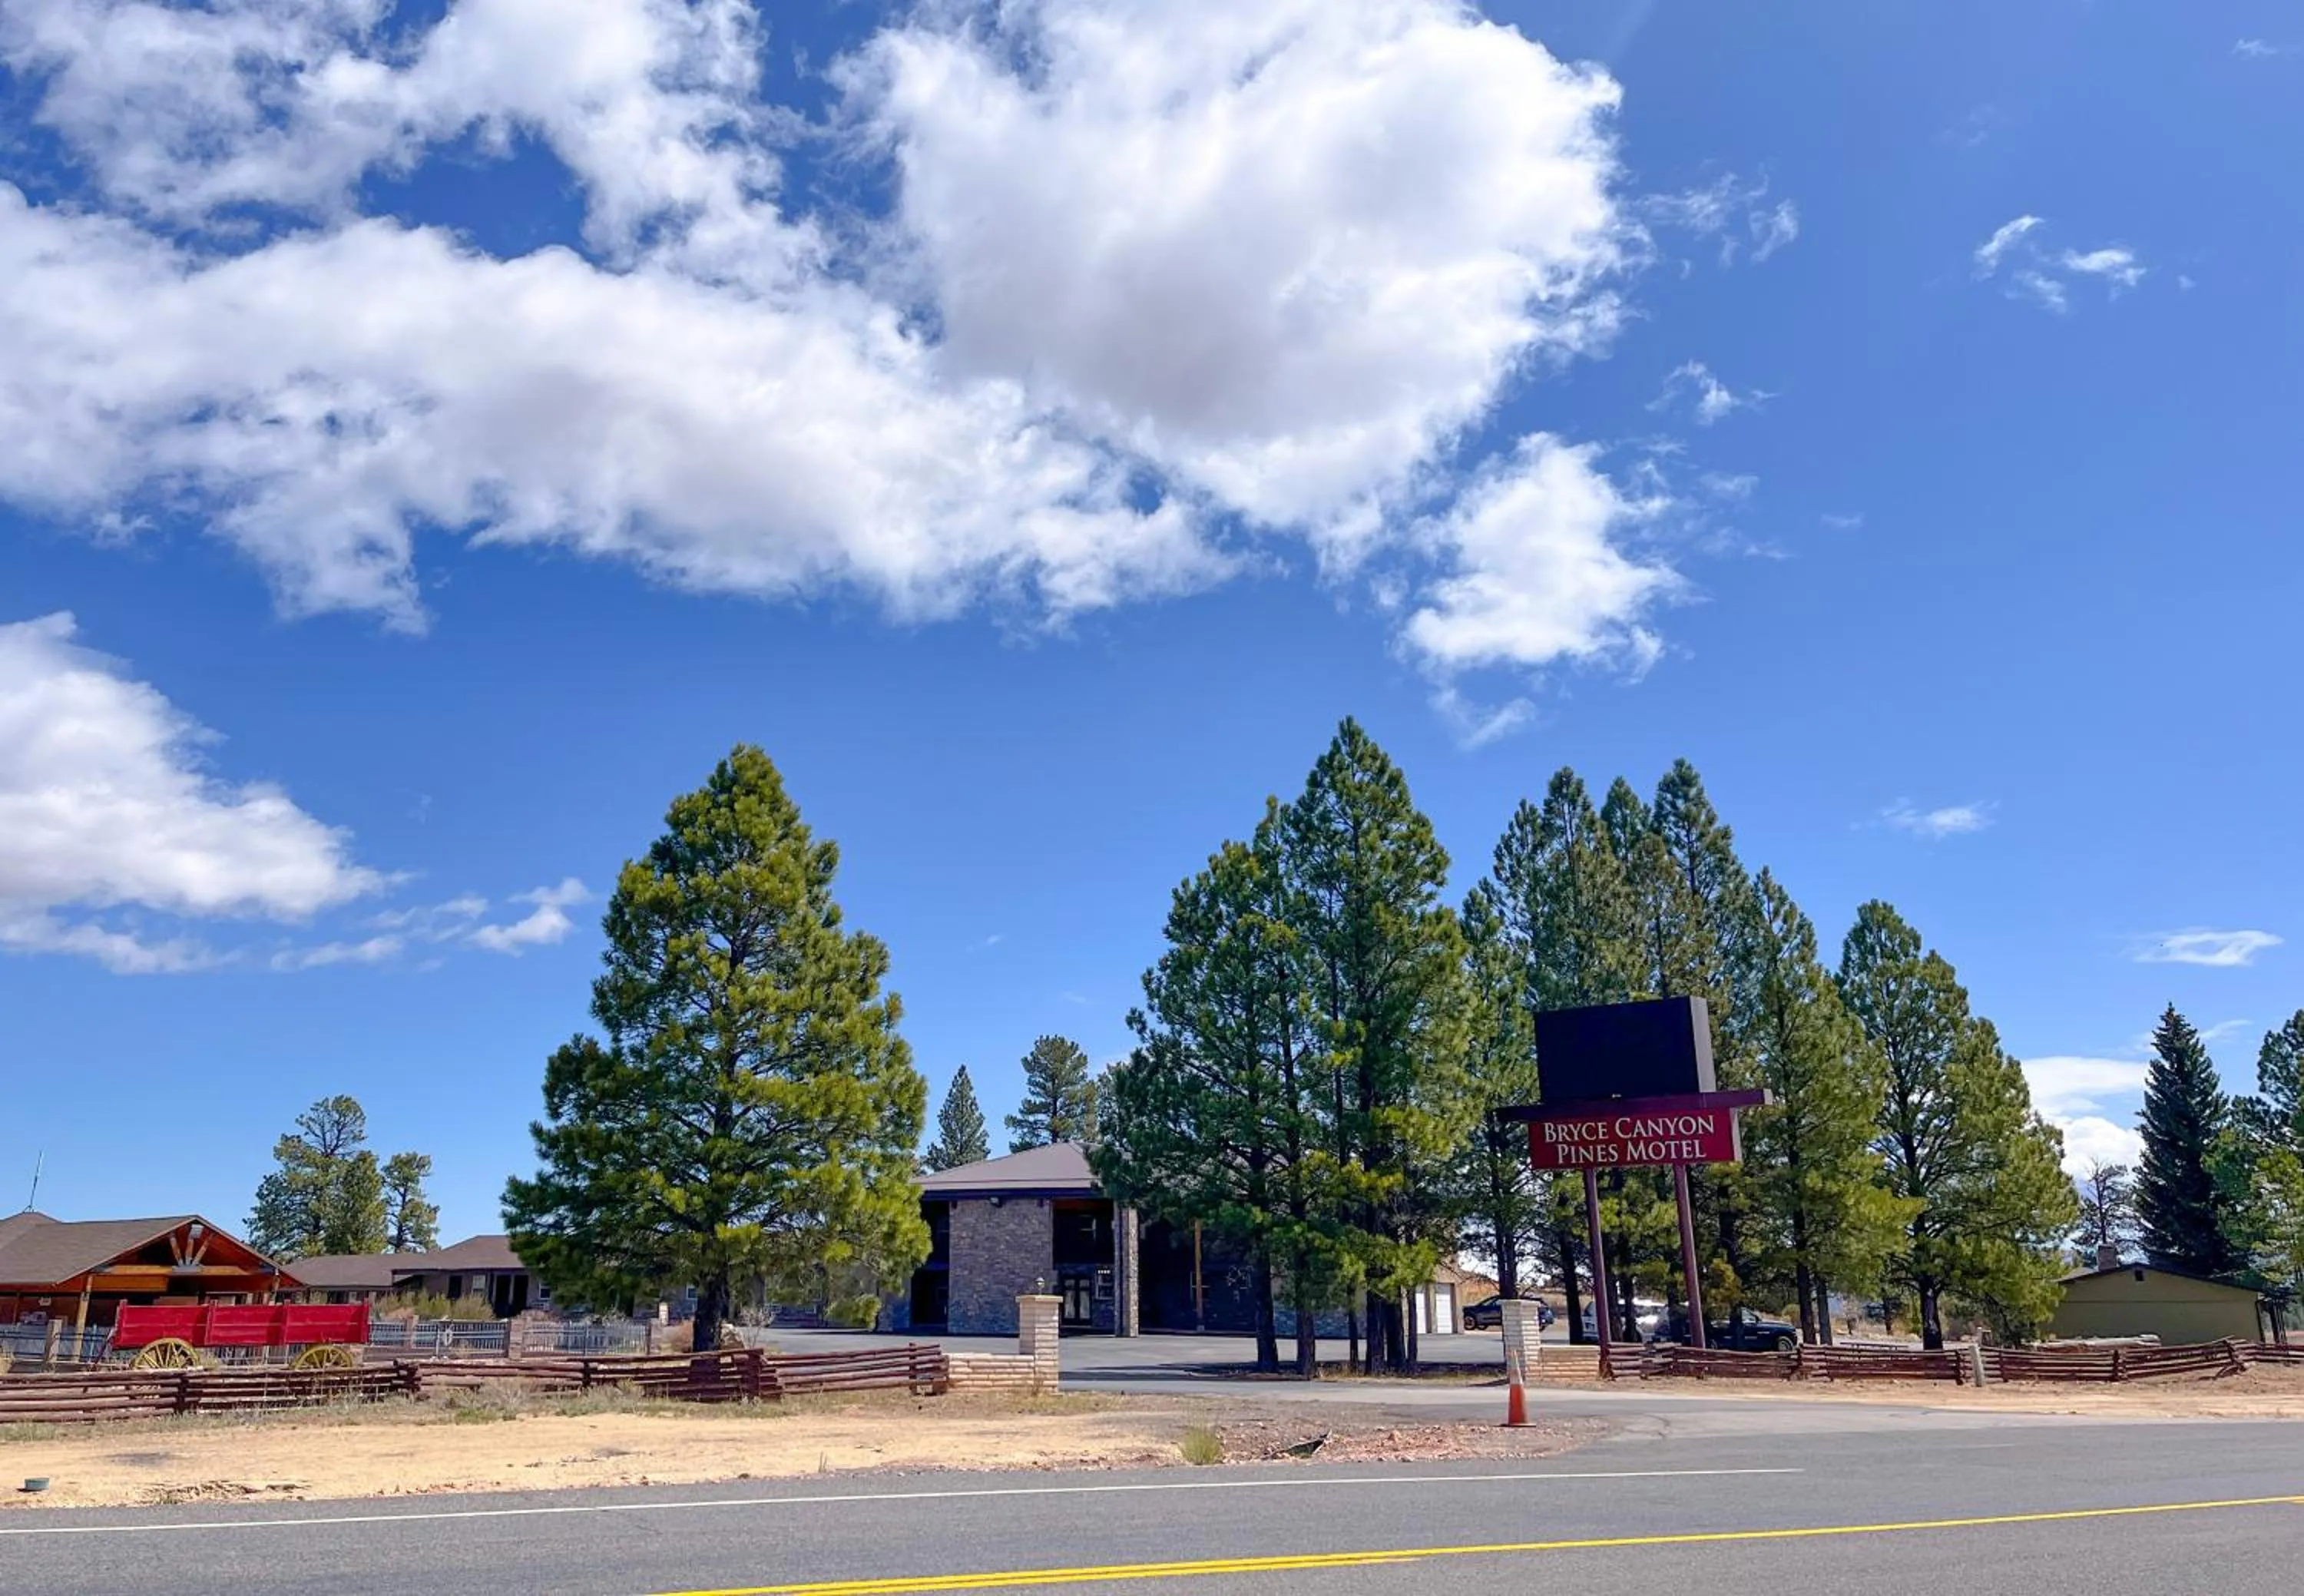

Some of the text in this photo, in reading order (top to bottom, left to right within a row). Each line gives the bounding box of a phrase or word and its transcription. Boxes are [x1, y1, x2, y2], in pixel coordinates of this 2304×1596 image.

[1544, 1115, 1715, 1143] BRYCE CANYON
[1557, 1139, 1707, 1164] PINES MOTEL
